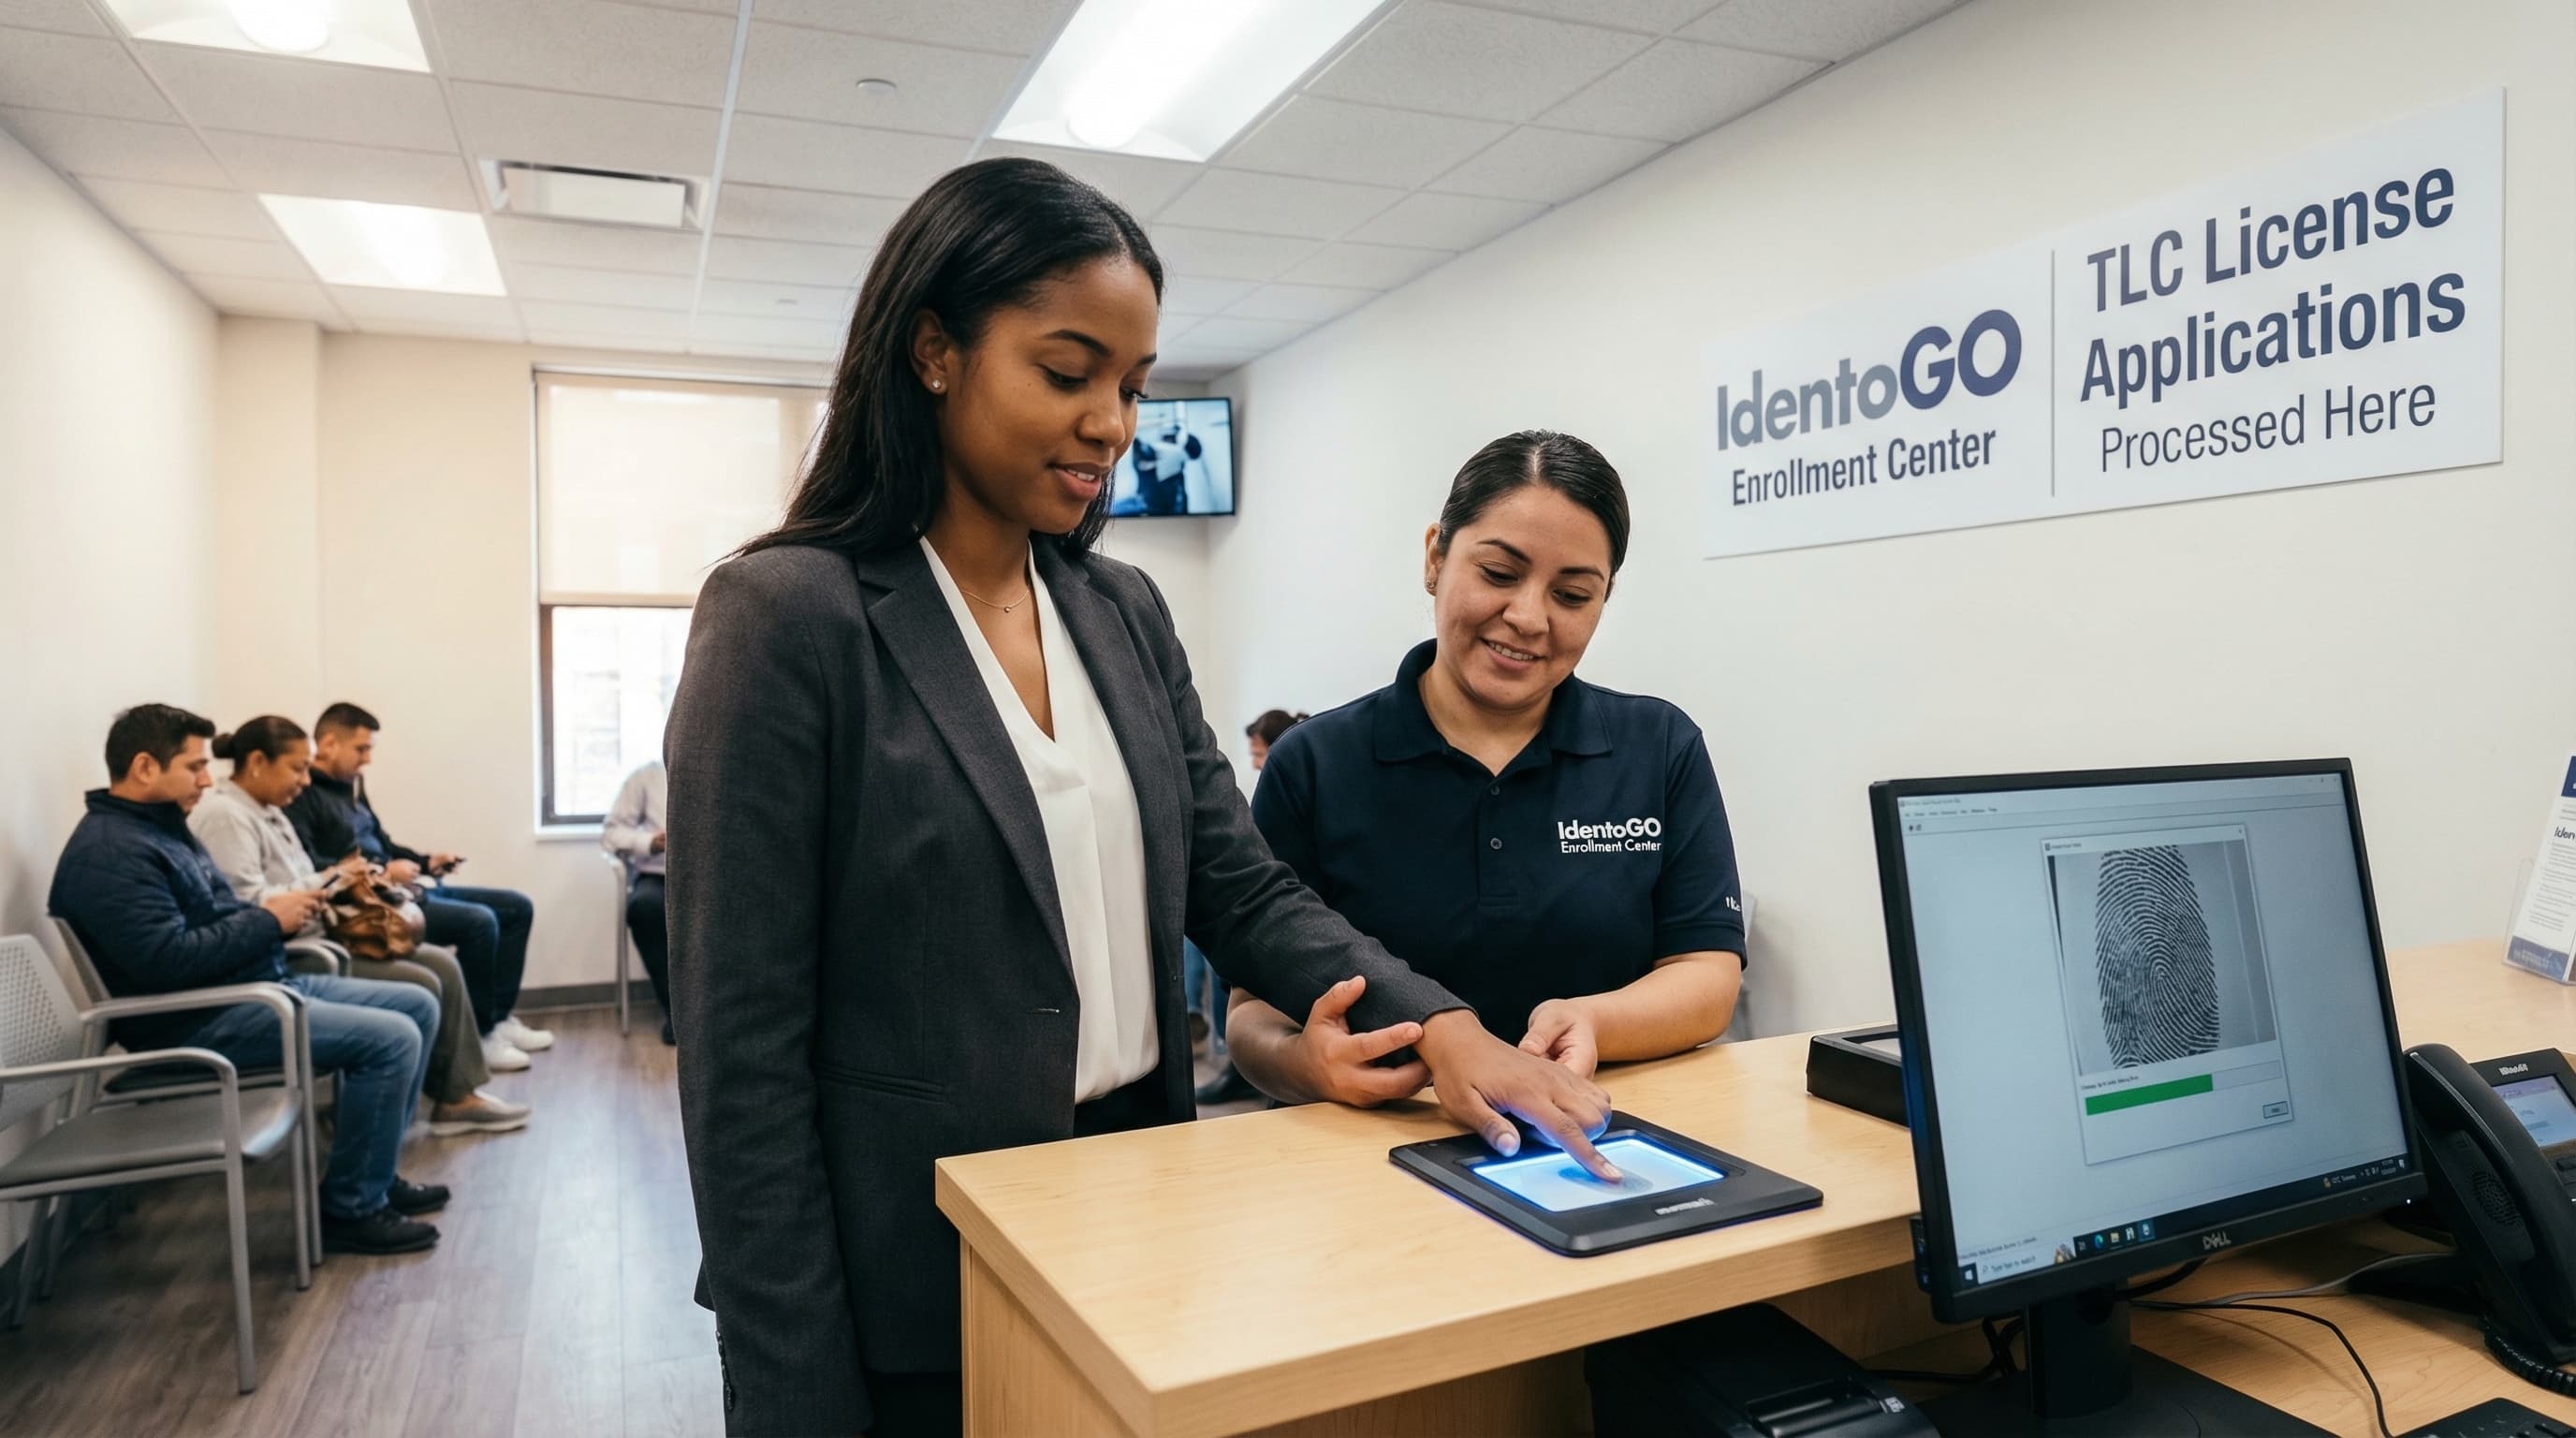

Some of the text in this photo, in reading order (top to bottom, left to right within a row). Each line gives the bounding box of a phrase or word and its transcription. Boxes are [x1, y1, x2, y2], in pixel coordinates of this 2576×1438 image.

[2086, 167, 2455, 313] TLC License
[1716, 308, 2023, 452] IdentoGO
[2080, 271, 2466, 410] Applications
[1732, 428, 1997, 506] Enrollment Center
[2101, 384, 2436, 473] Processed Here
[1557, 817, 1662, 840] IdentoGO
[1560, 838, 1662, 854] Enrollment Center
[2202, 1230, 2232, 1251] DELL
